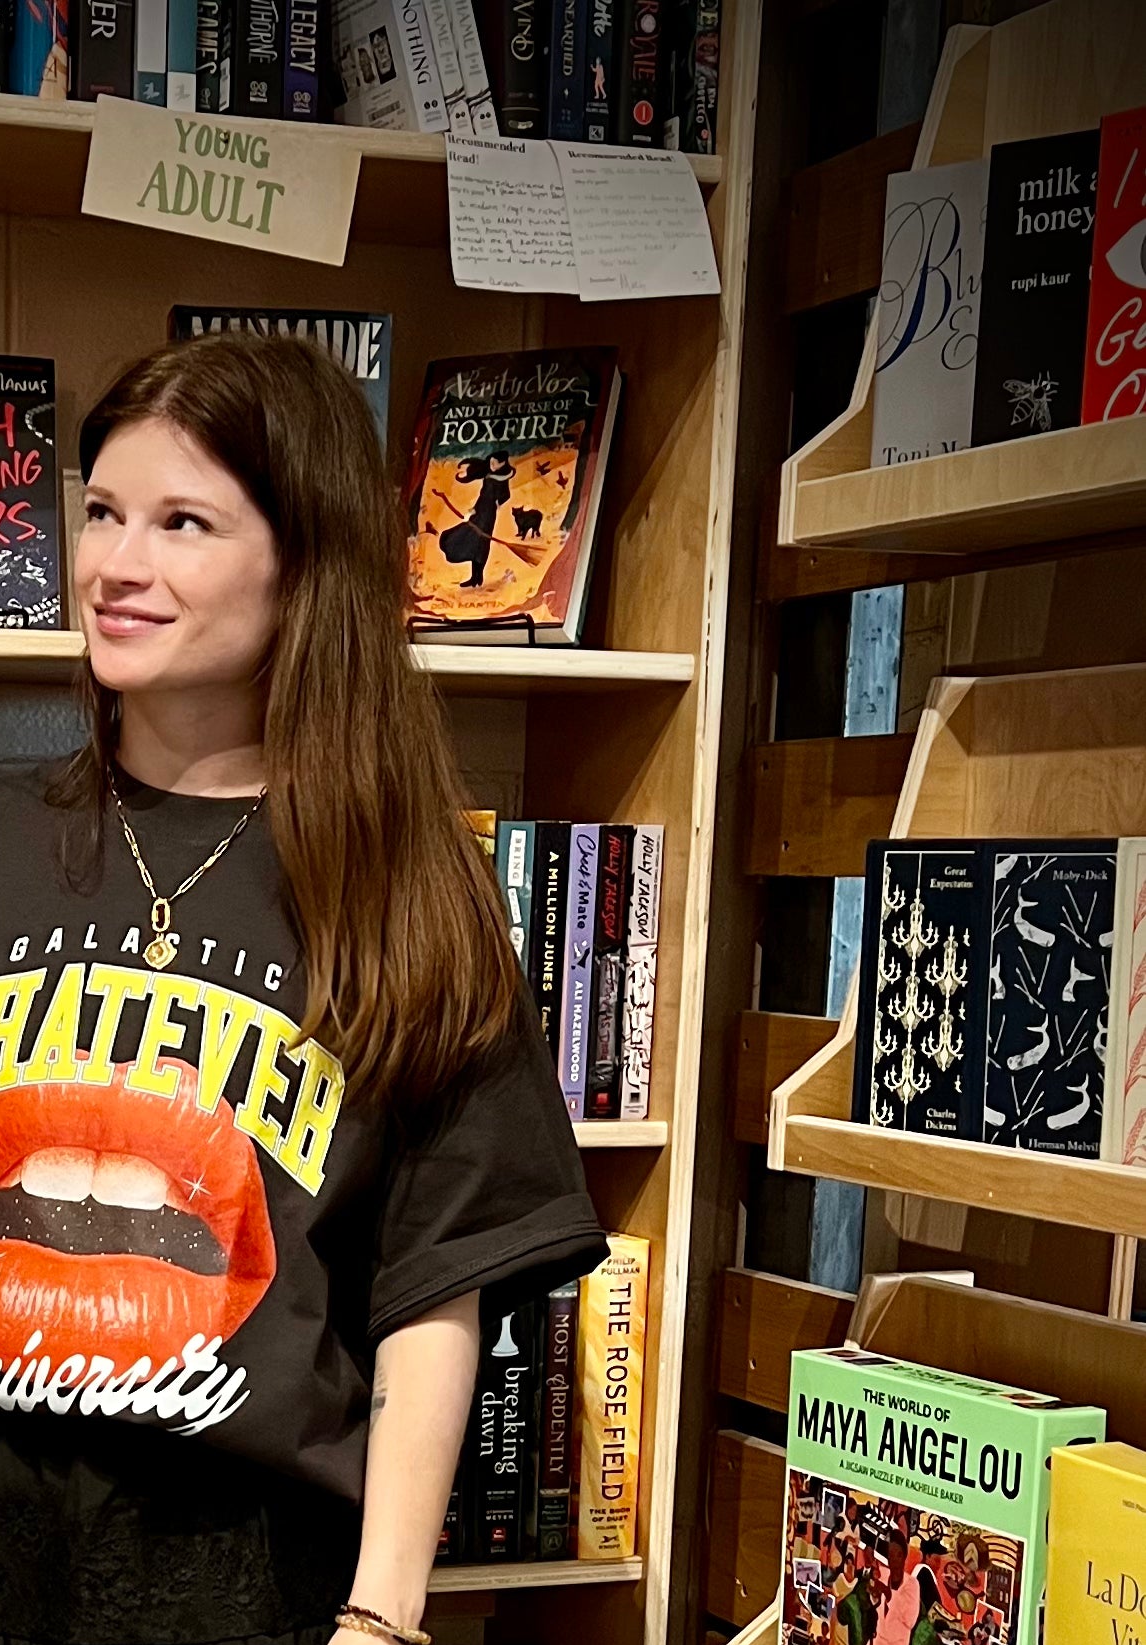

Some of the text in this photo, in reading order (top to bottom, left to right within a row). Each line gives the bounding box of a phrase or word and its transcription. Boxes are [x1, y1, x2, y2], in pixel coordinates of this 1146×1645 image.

[175, 118, 270, 168] YOUNG
[136, 161, 285, 234] ADULT
[1019, 168, 1081, 202] milk
[1016, 206, 1096, 236] honey
[1011, 273, 1070, 291] rupi kaur
[445, 399, 573, 419] AND THE CURSE OF
[438, 414, 569, 446] FOXFIRE
[944, 866, 967, 876] Great
[1053, 870, 1108, 881] Moby-Dick
[926, 1109, 956, 1118] Charles
[926, 1121, 956, 1131] Dickens
[546, 1314, 569, 1474] MOST ARDENTLY
[601, 1282, 632, 1501] THE ROSE FIELD
[863, 1388, 951, 1422] THE WORLD OF
[480, 1392, 503, 1457] dawn
[493, 1366, 529, 1474] breaking
[797, 1393, 1022, 1500] MAYA ANGELOU
[840, 1459, 963, 1504] A JIGSAW PUZZLE BY RACHELLE BAKER
[1087, 1561, 1111, 1605] La
